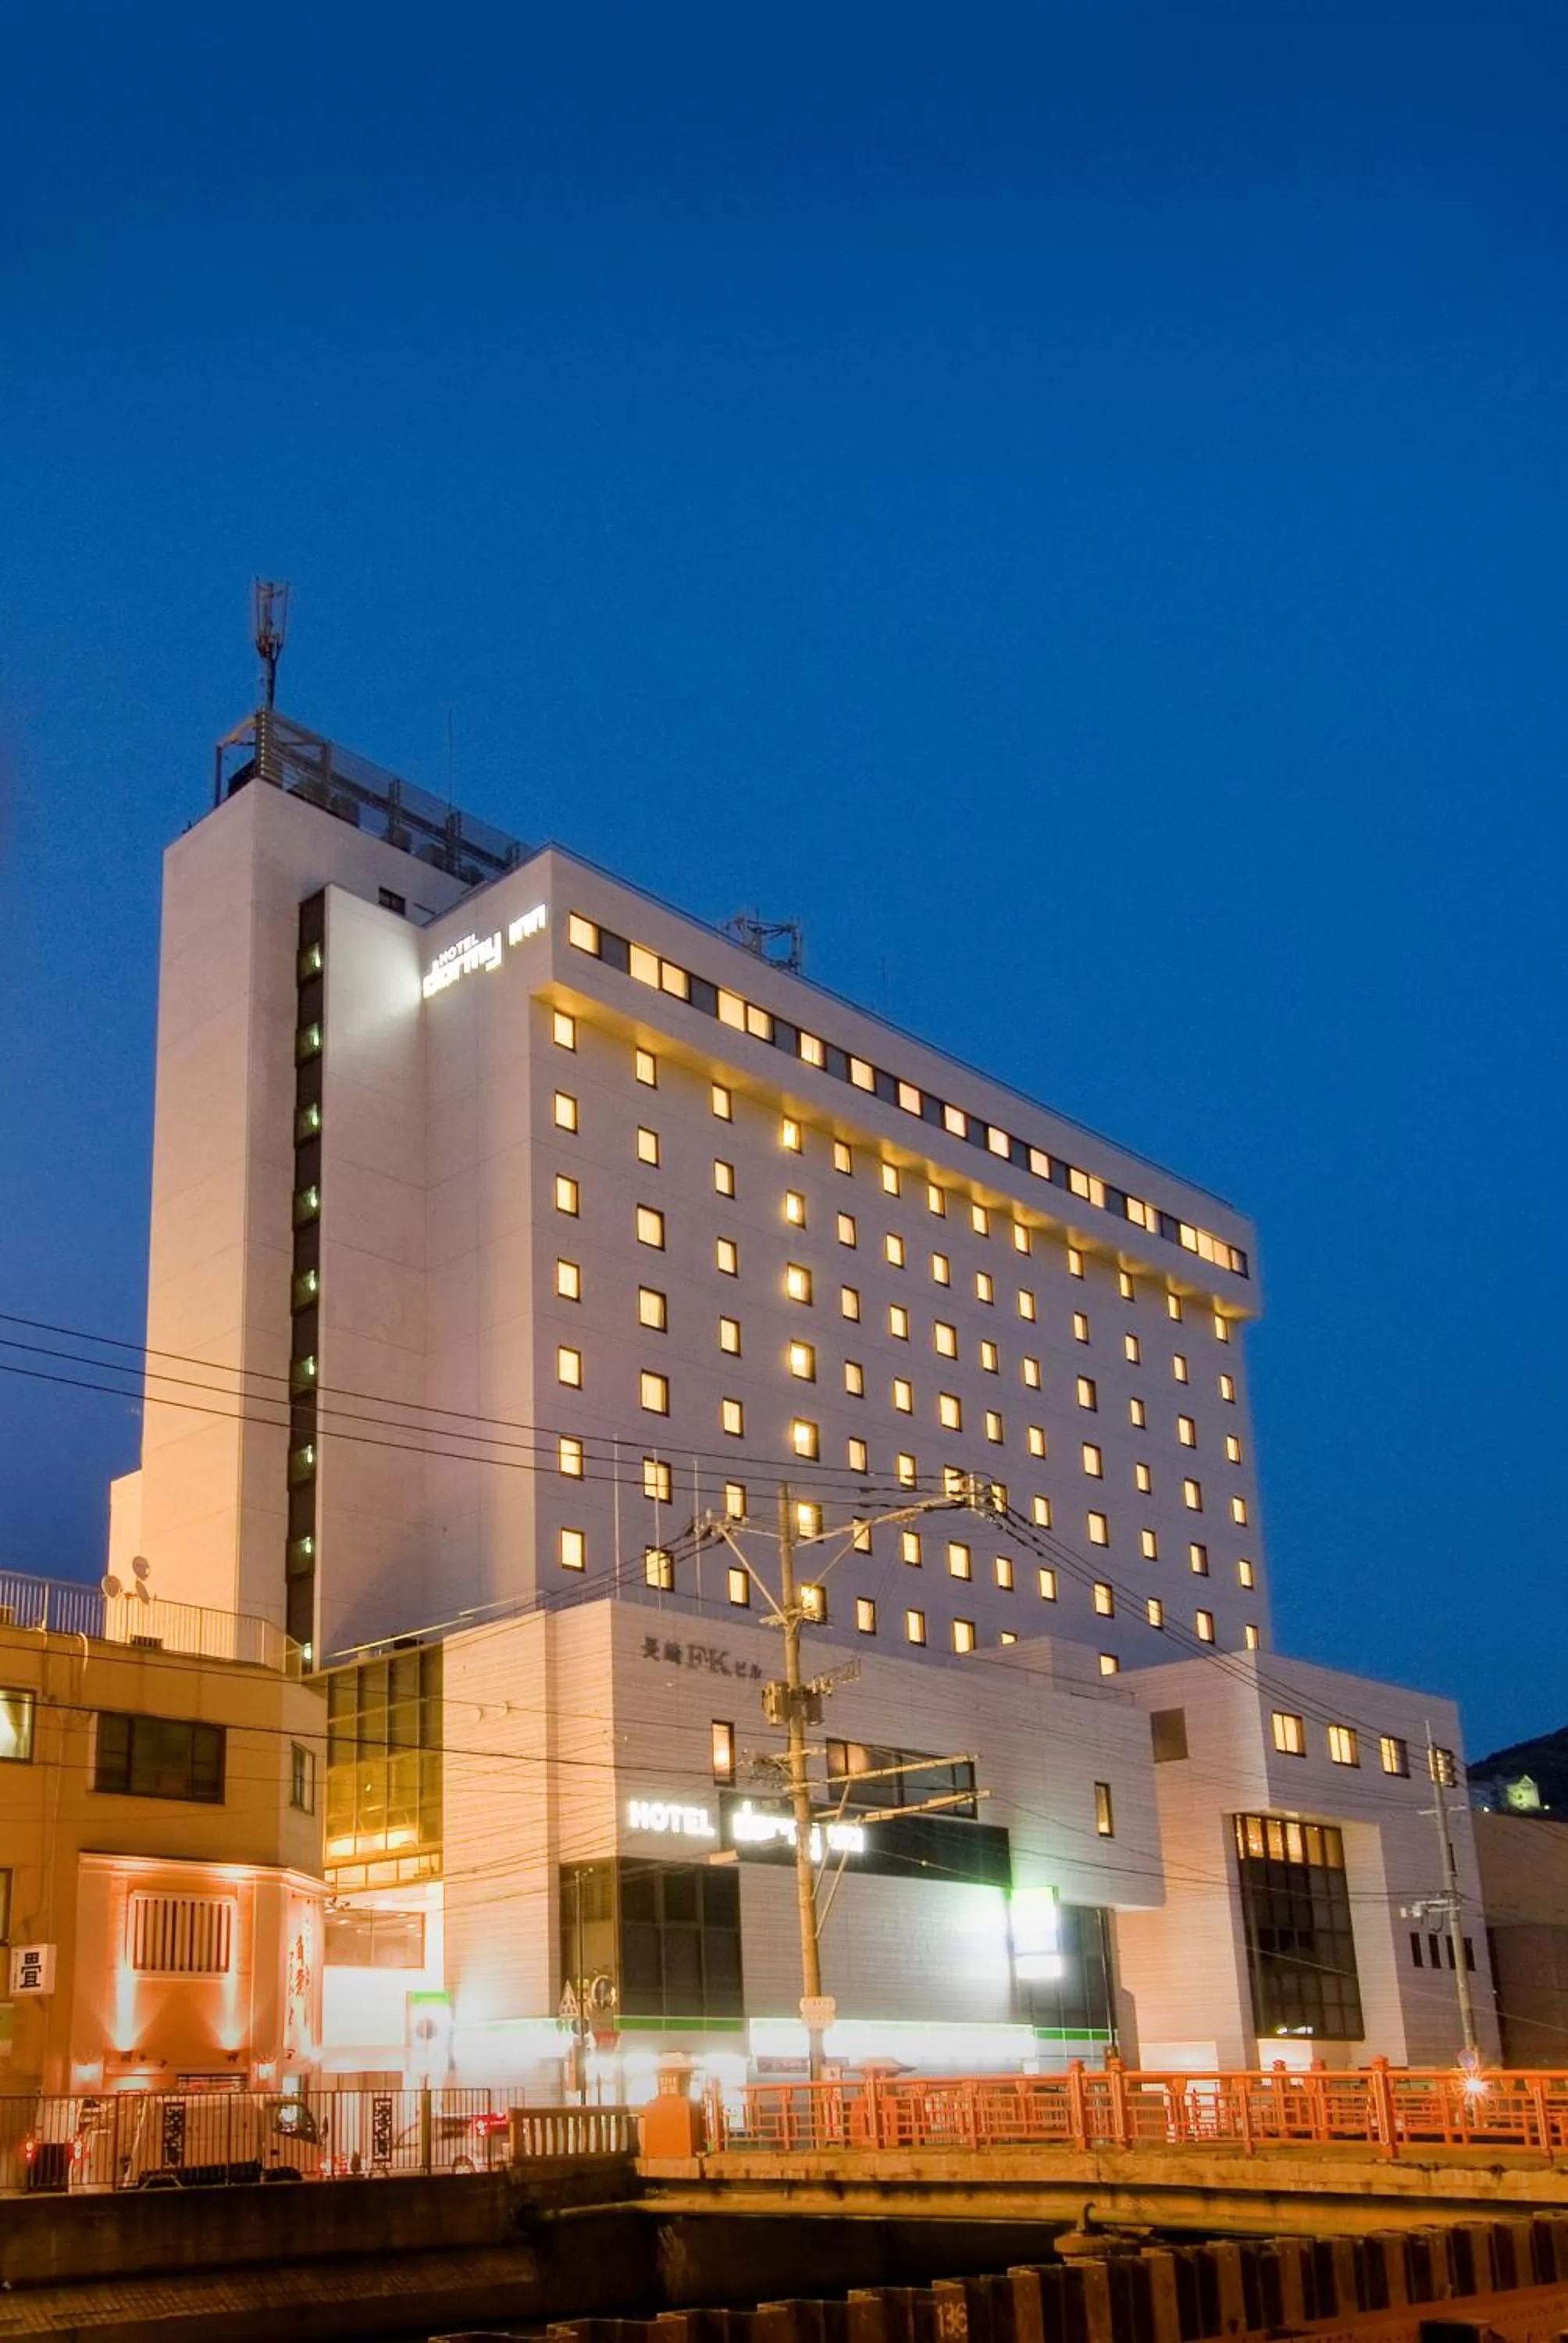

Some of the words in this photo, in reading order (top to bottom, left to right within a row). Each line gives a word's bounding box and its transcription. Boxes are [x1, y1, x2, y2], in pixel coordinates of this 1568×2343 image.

[438, 933, 479, 966] HOTEL
[629, 1799, 715, 1837] HOTEL
[20, 1952, 41, 1989] 畳
